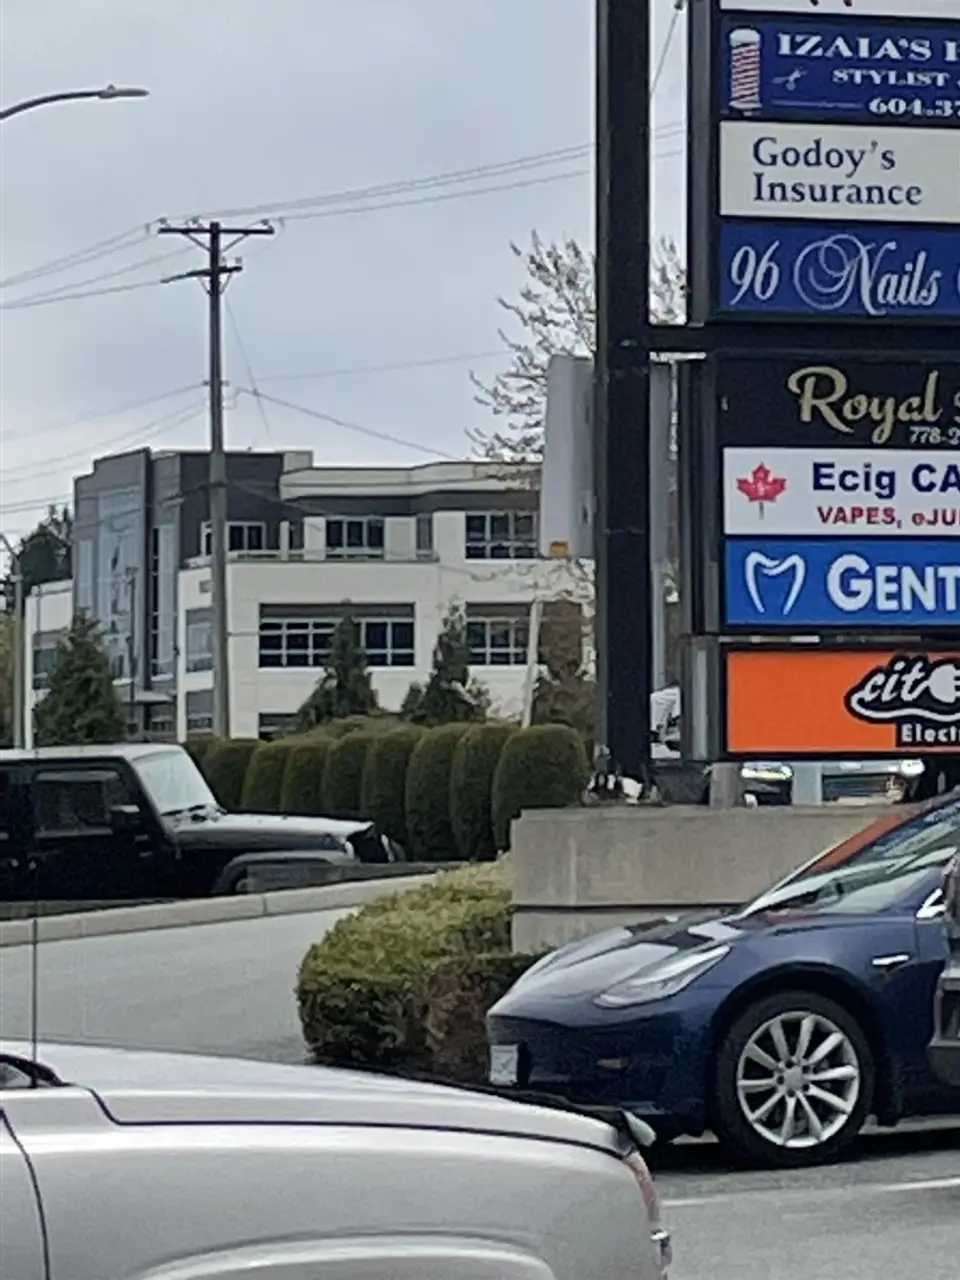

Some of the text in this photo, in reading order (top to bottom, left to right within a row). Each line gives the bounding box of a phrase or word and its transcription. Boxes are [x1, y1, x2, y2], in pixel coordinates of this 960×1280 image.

[832, 68, 950, 89] STYLIST
[752, 136, 896, 179] Godoy's
[752, 172, 923, 207] Insurance
[729, 240, 781, 306] 96
[793, 233, 942, 317] Nails
[787, 365, 943, 446] Royal
[812, 462, 896, 499] Ecig
[817, 506, 903, 529] VAPES,
